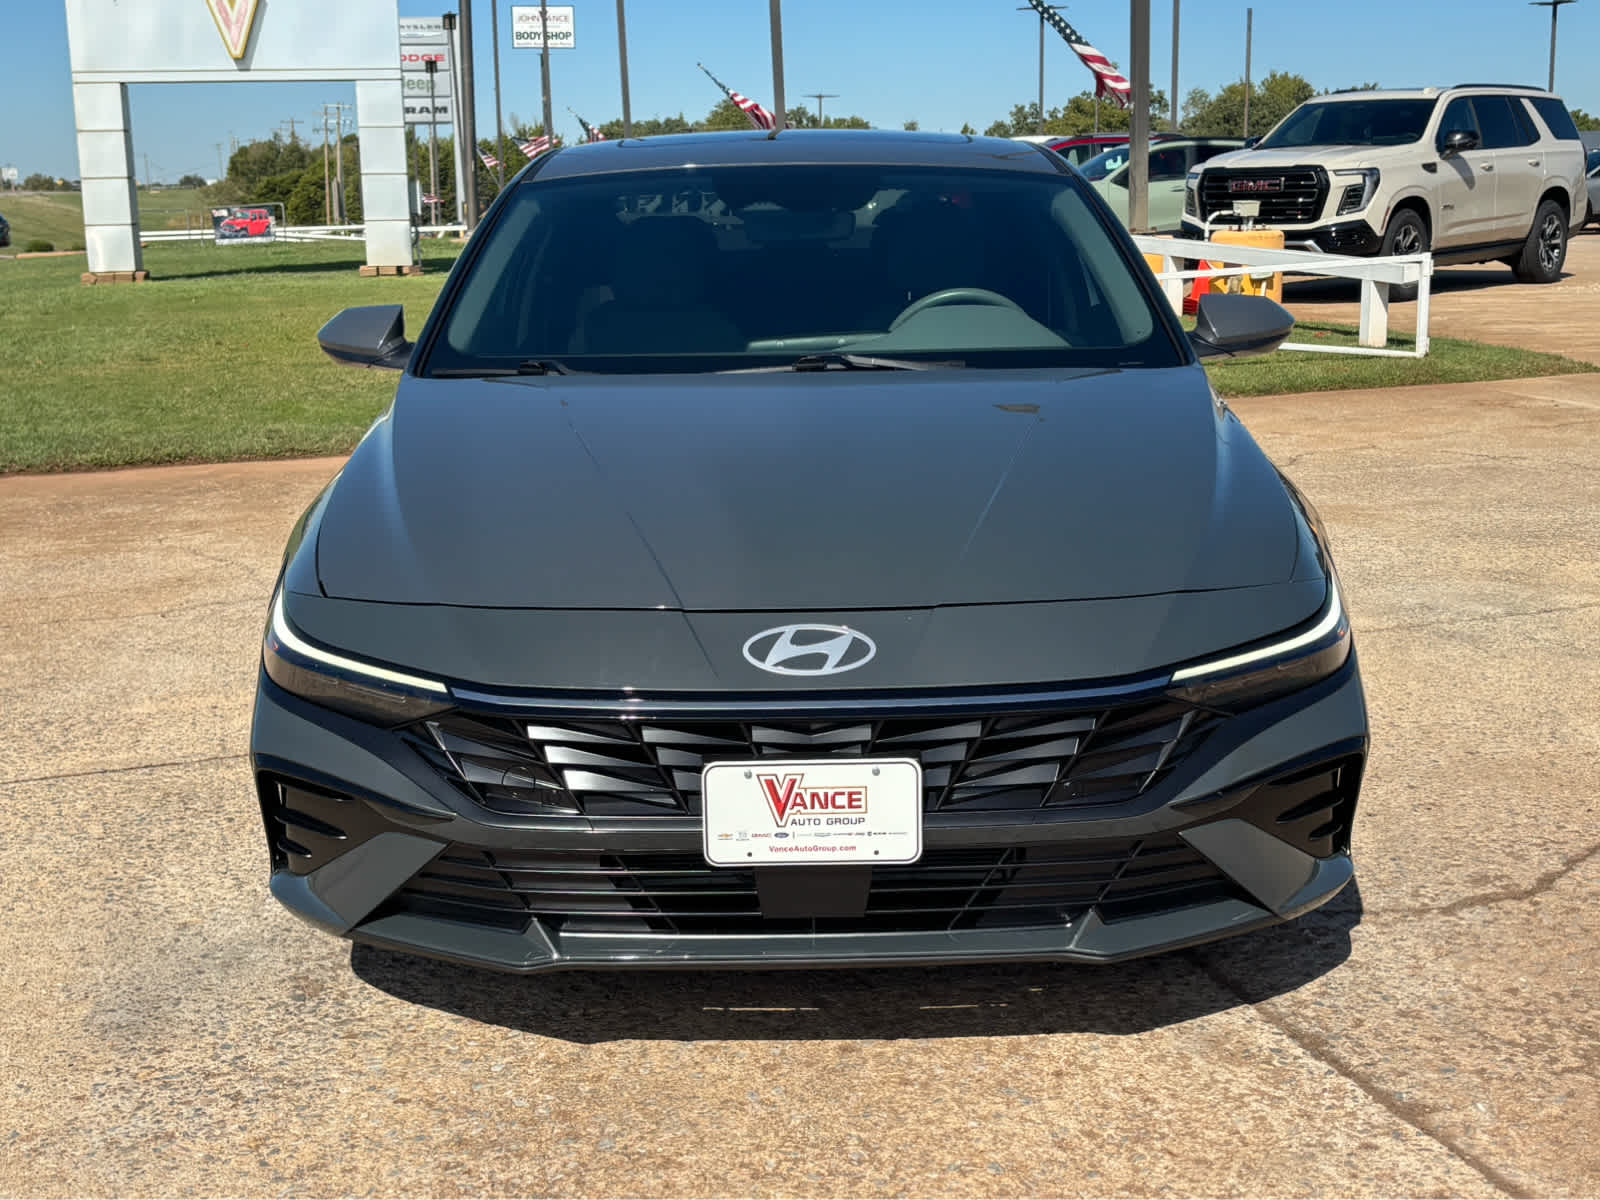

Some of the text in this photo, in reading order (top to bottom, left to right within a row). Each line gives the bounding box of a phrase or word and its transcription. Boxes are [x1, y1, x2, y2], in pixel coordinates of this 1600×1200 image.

[515, 31, 572, 40] BODY SHOP
[404, 106, 448, 114] RAM
[1231, 180, 1280, 192] GMC
[761, 776, 865, 824] VANCE
[790, 816, 866, 827] AUTO GROUP
[768, 844, 857, 854] VanceAutoGroup.com
